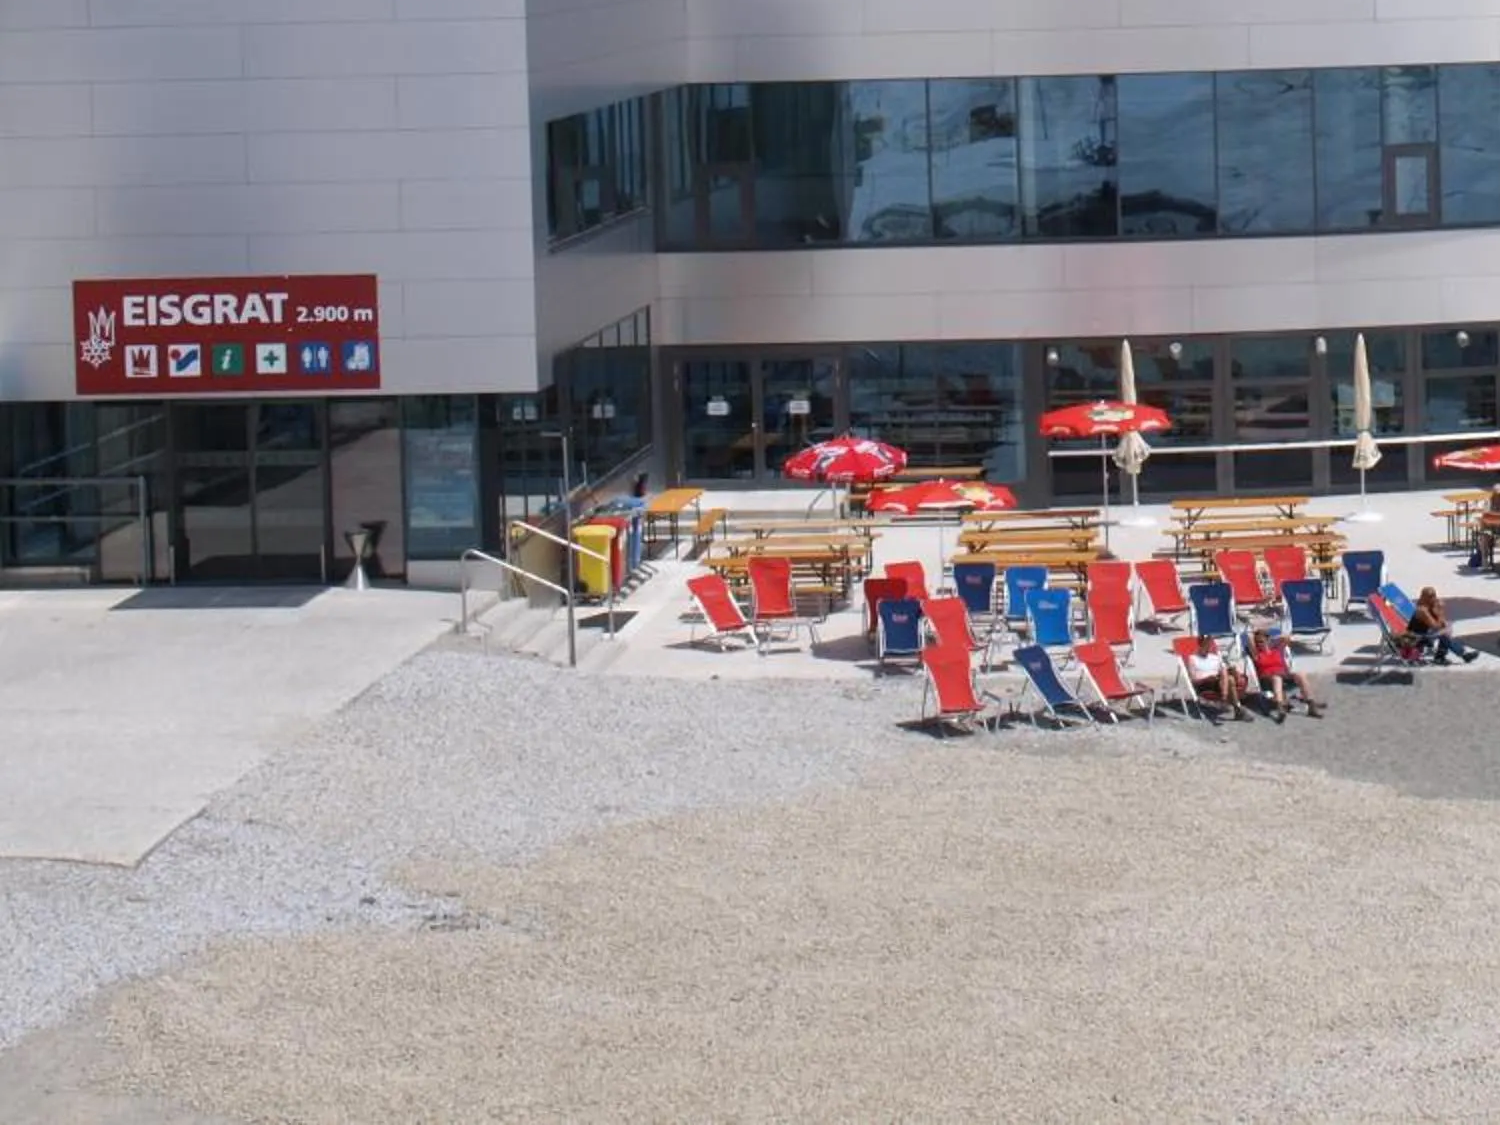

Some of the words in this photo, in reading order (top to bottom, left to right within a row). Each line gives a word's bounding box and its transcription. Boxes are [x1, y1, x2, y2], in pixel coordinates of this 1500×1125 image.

[122, 292, 289, 326] EISGRAT
[296, 306, 347, 322] 2.900
[353, 307, 373, 321] m
